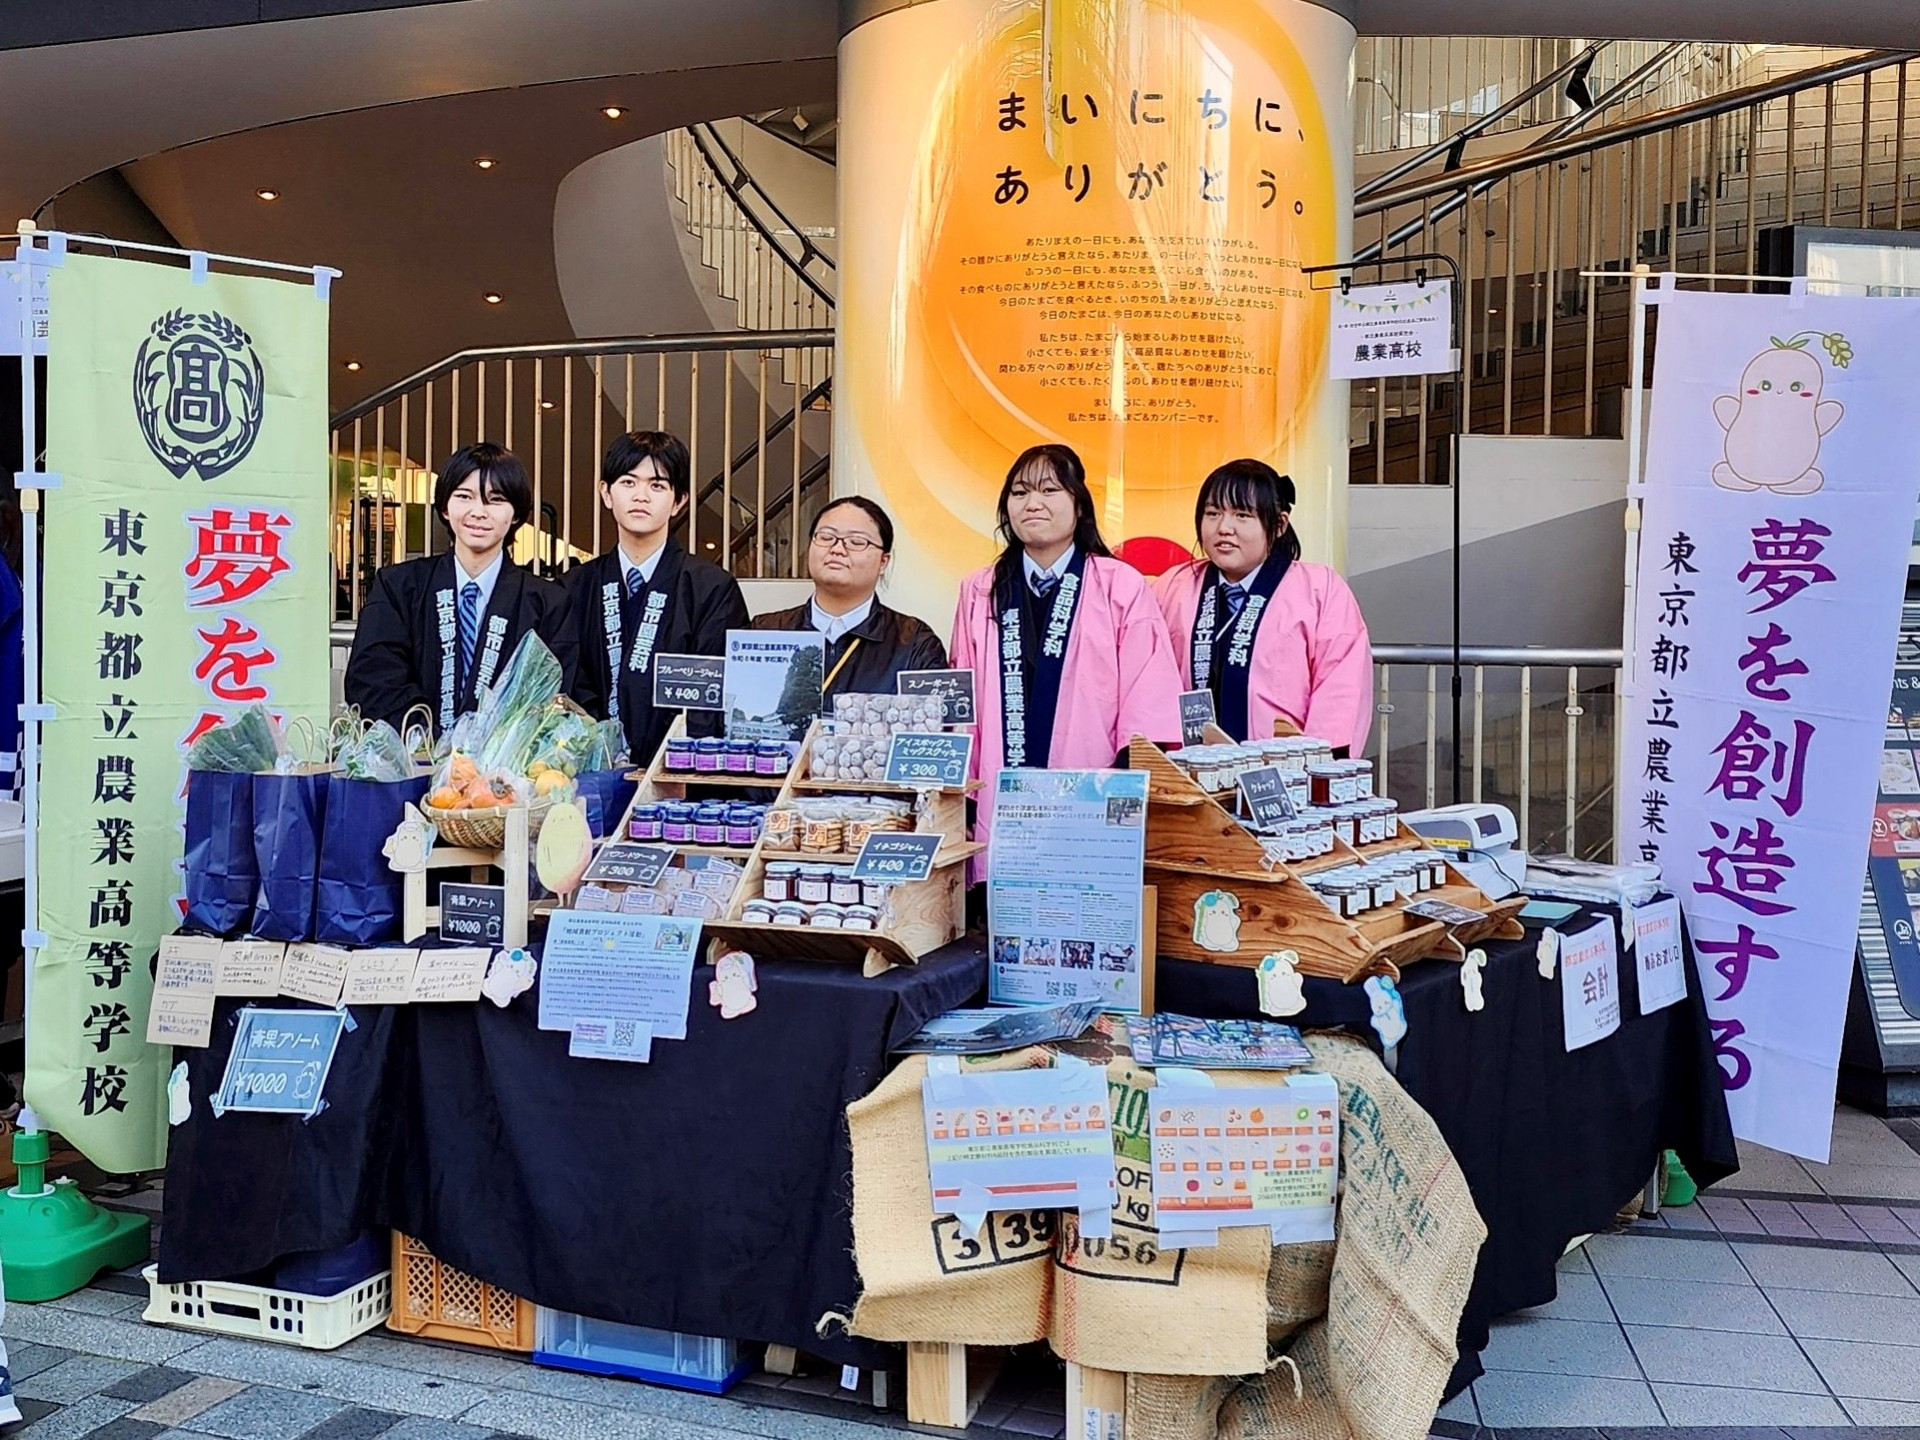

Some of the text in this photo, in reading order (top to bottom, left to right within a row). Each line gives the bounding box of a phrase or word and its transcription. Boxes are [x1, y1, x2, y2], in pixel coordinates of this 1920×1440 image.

[998, 88, 1304, 142] まいにちに、
[994, 161, 1304, 215] ありがとう。
[1040, 333, 1245, 345] 私たちは、たまごら始まるしあわせを届けたい。
[1026, 347, 1254, 360] 小さくても、安全・安で高品質なしあわせを届けたい。
[1354, 340, 1422, 362] 農業高校
[999, 362, 1277, 377] 関わる方々へのありがとうこめて、鶏たちへのありがとうをこめて、
[1040, 377, 1244, 389] 小さくても、たくのしあわせを創り続けたい。
[1094, 398, 1197, 409] まいちに、ありがとう。
[436, 588, 456, 731] 東京都立農業高等
[657, 664, 722, 678] ブルーベリージャム
[908, 678, 959, 689] スノーボール
[930, 688, 965, 697] クッキー
[78, 507, 148, 1117] 東京都立農業高等学校
[1693, 518, 1837, 1091] 夢を創造する
[873, 841, 924, 852] イチゴジャム
[450, 894, 496, 909] 青果アソート
[447, 918, 481, 934] ¥1000
[1582, 963, 1609, 1006] 会計
[251, 1028, 320, 1049] 青果アソート
[235, 1071, 288, 1094] ¥1000
